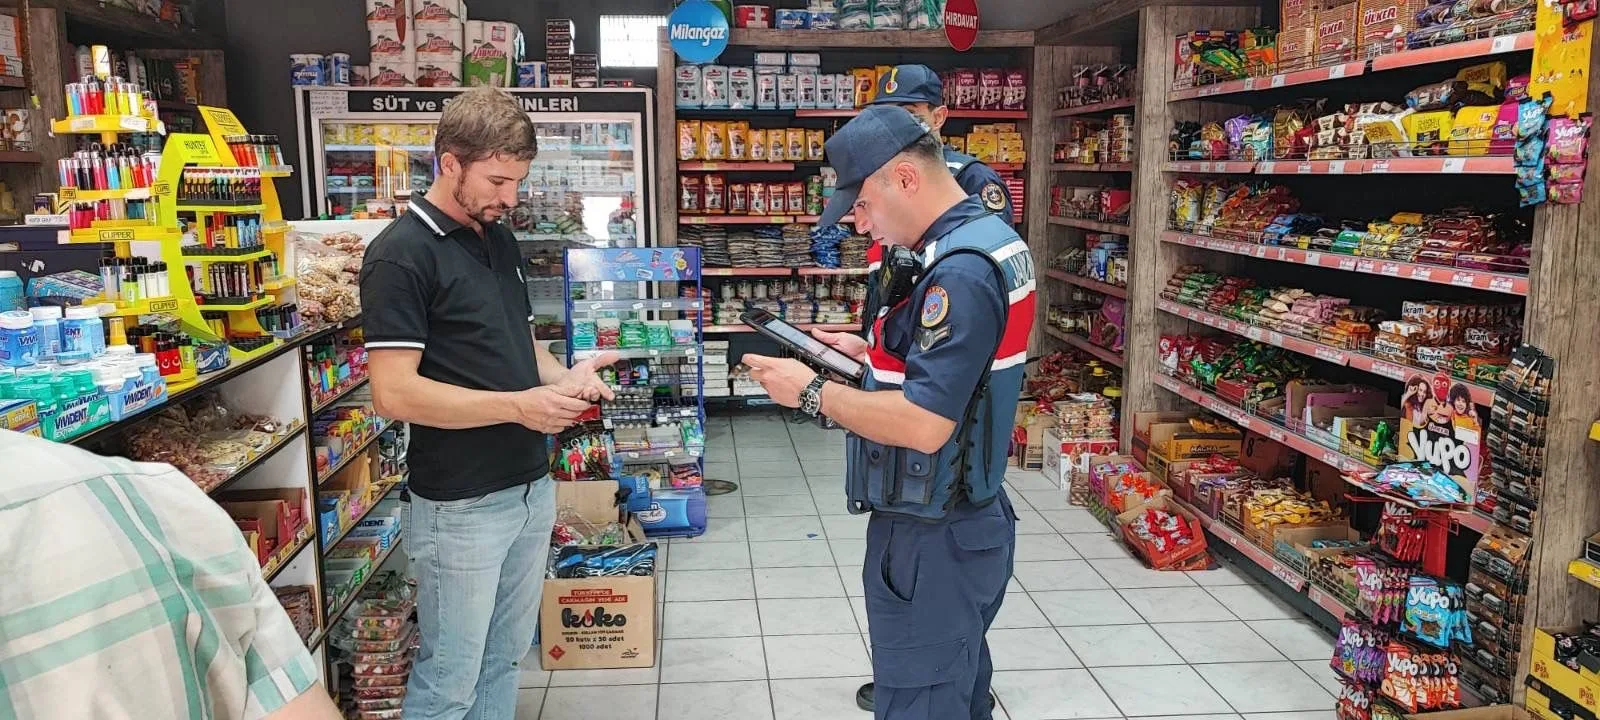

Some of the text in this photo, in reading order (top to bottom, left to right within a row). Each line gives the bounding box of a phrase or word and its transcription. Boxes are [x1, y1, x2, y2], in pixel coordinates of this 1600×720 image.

[945, 11, 978, 29] HIRDAVAT
[1364, 8, 1396, 25] ÜLKER
[671, 23, 725, 46] Milangaz
[1320, 21, 1344, 37] ÜLKER
[373, 95, 410, 111] SÜT
[415, 100, 437, 111] ve
[102, 231, 132, 239] CLIPPER
[152, 302, 176, 312] CLIPPER
[123, 385, 152, 404] VIVIDENT
[55, 407, 87, 430] VIVIDENT
[561, 606, 627, 628] koko
